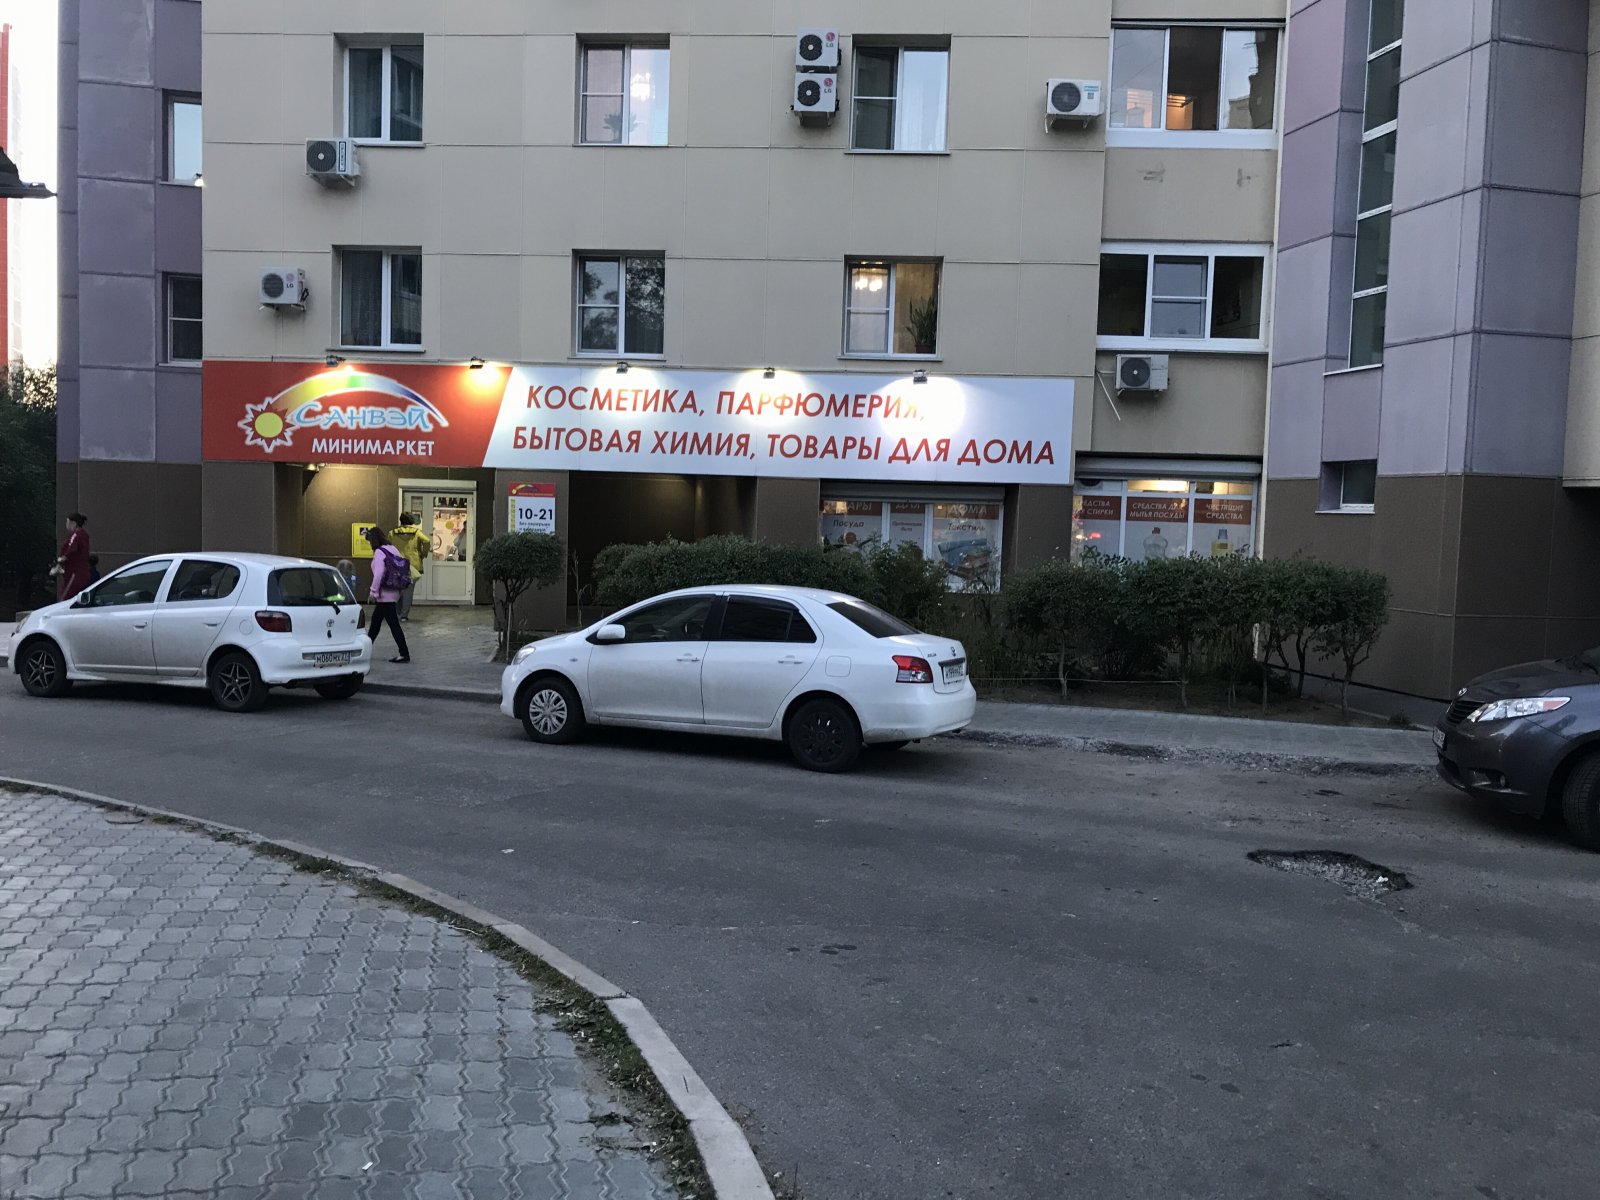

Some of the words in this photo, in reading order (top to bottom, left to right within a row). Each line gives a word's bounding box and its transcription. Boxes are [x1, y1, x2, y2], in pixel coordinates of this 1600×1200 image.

[527, 385, 705, 417] КОСМЕТИКА,
[716, 390, 926, 421] ПАРФЮМЕРИЯ,
[311, 438, 435, 456] МИНИМАРКЕТ
[513, 426, 642, 453] БЫТОВАЯ
[650, 430, 755, 460] ХИМИЯ,
[767, 434, 882, 460] ТОВАРЫ
[888, 437, 951, 464] ДЛЯ
[957, 439, 1055, 466] ДОМА
[1132, 502, 1167, 510] СРЕДСТВА
[518, 508, 553, 520] 10-21
[1206, 512, 1243, 520] СРЕДСТВА
[833, 519, 864, 528] Посуда
